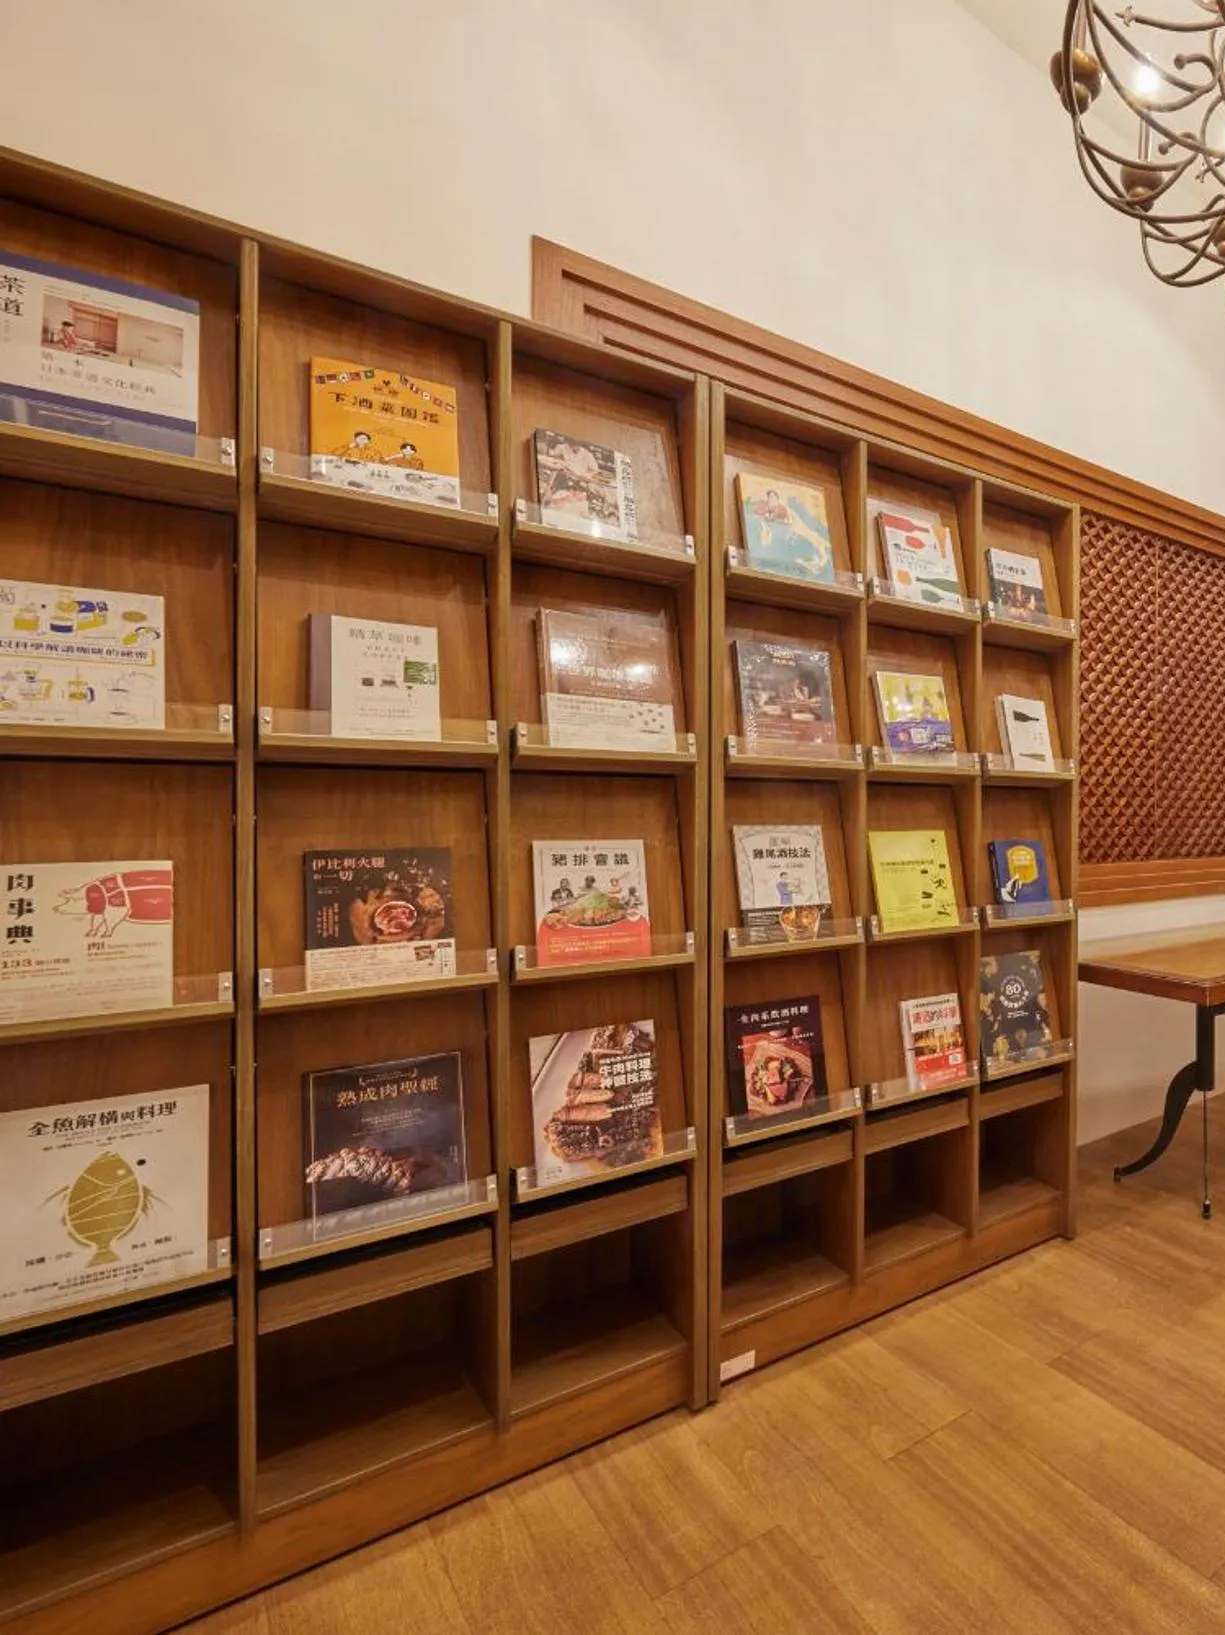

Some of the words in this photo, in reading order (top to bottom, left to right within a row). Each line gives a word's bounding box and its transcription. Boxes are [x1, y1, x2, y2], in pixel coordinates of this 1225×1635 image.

[312, 856, 386, 871] 伊比利火腿
[551, 853, 630, 867] 豬排會議
[6, 873, 35, 945] 肉事典
[336, 1075, 439, 1109] 熟成肉聖經
[27, 1101, 177, 1138] 全魚解構與料理
